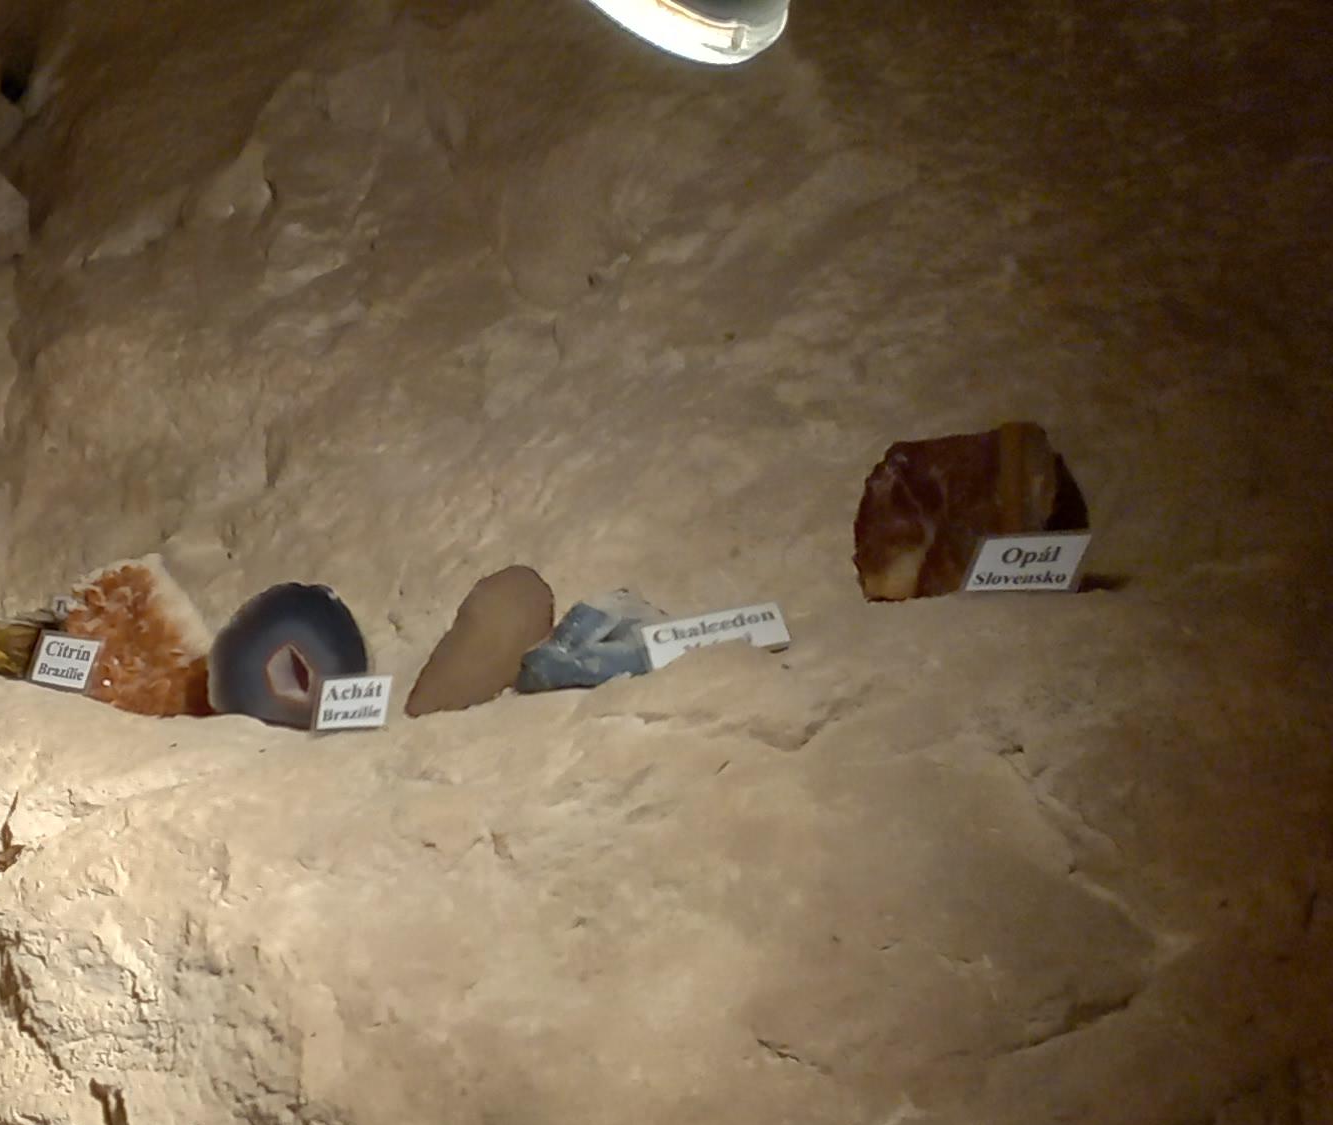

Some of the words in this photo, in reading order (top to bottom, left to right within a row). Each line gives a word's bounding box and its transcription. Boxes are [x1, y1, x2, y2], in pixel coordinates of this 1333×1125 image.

[1001, 545, 1062, 568] Opál
[974, 571, 1067, 586] Slovensko
[324, 680, 383, 702] Achát
